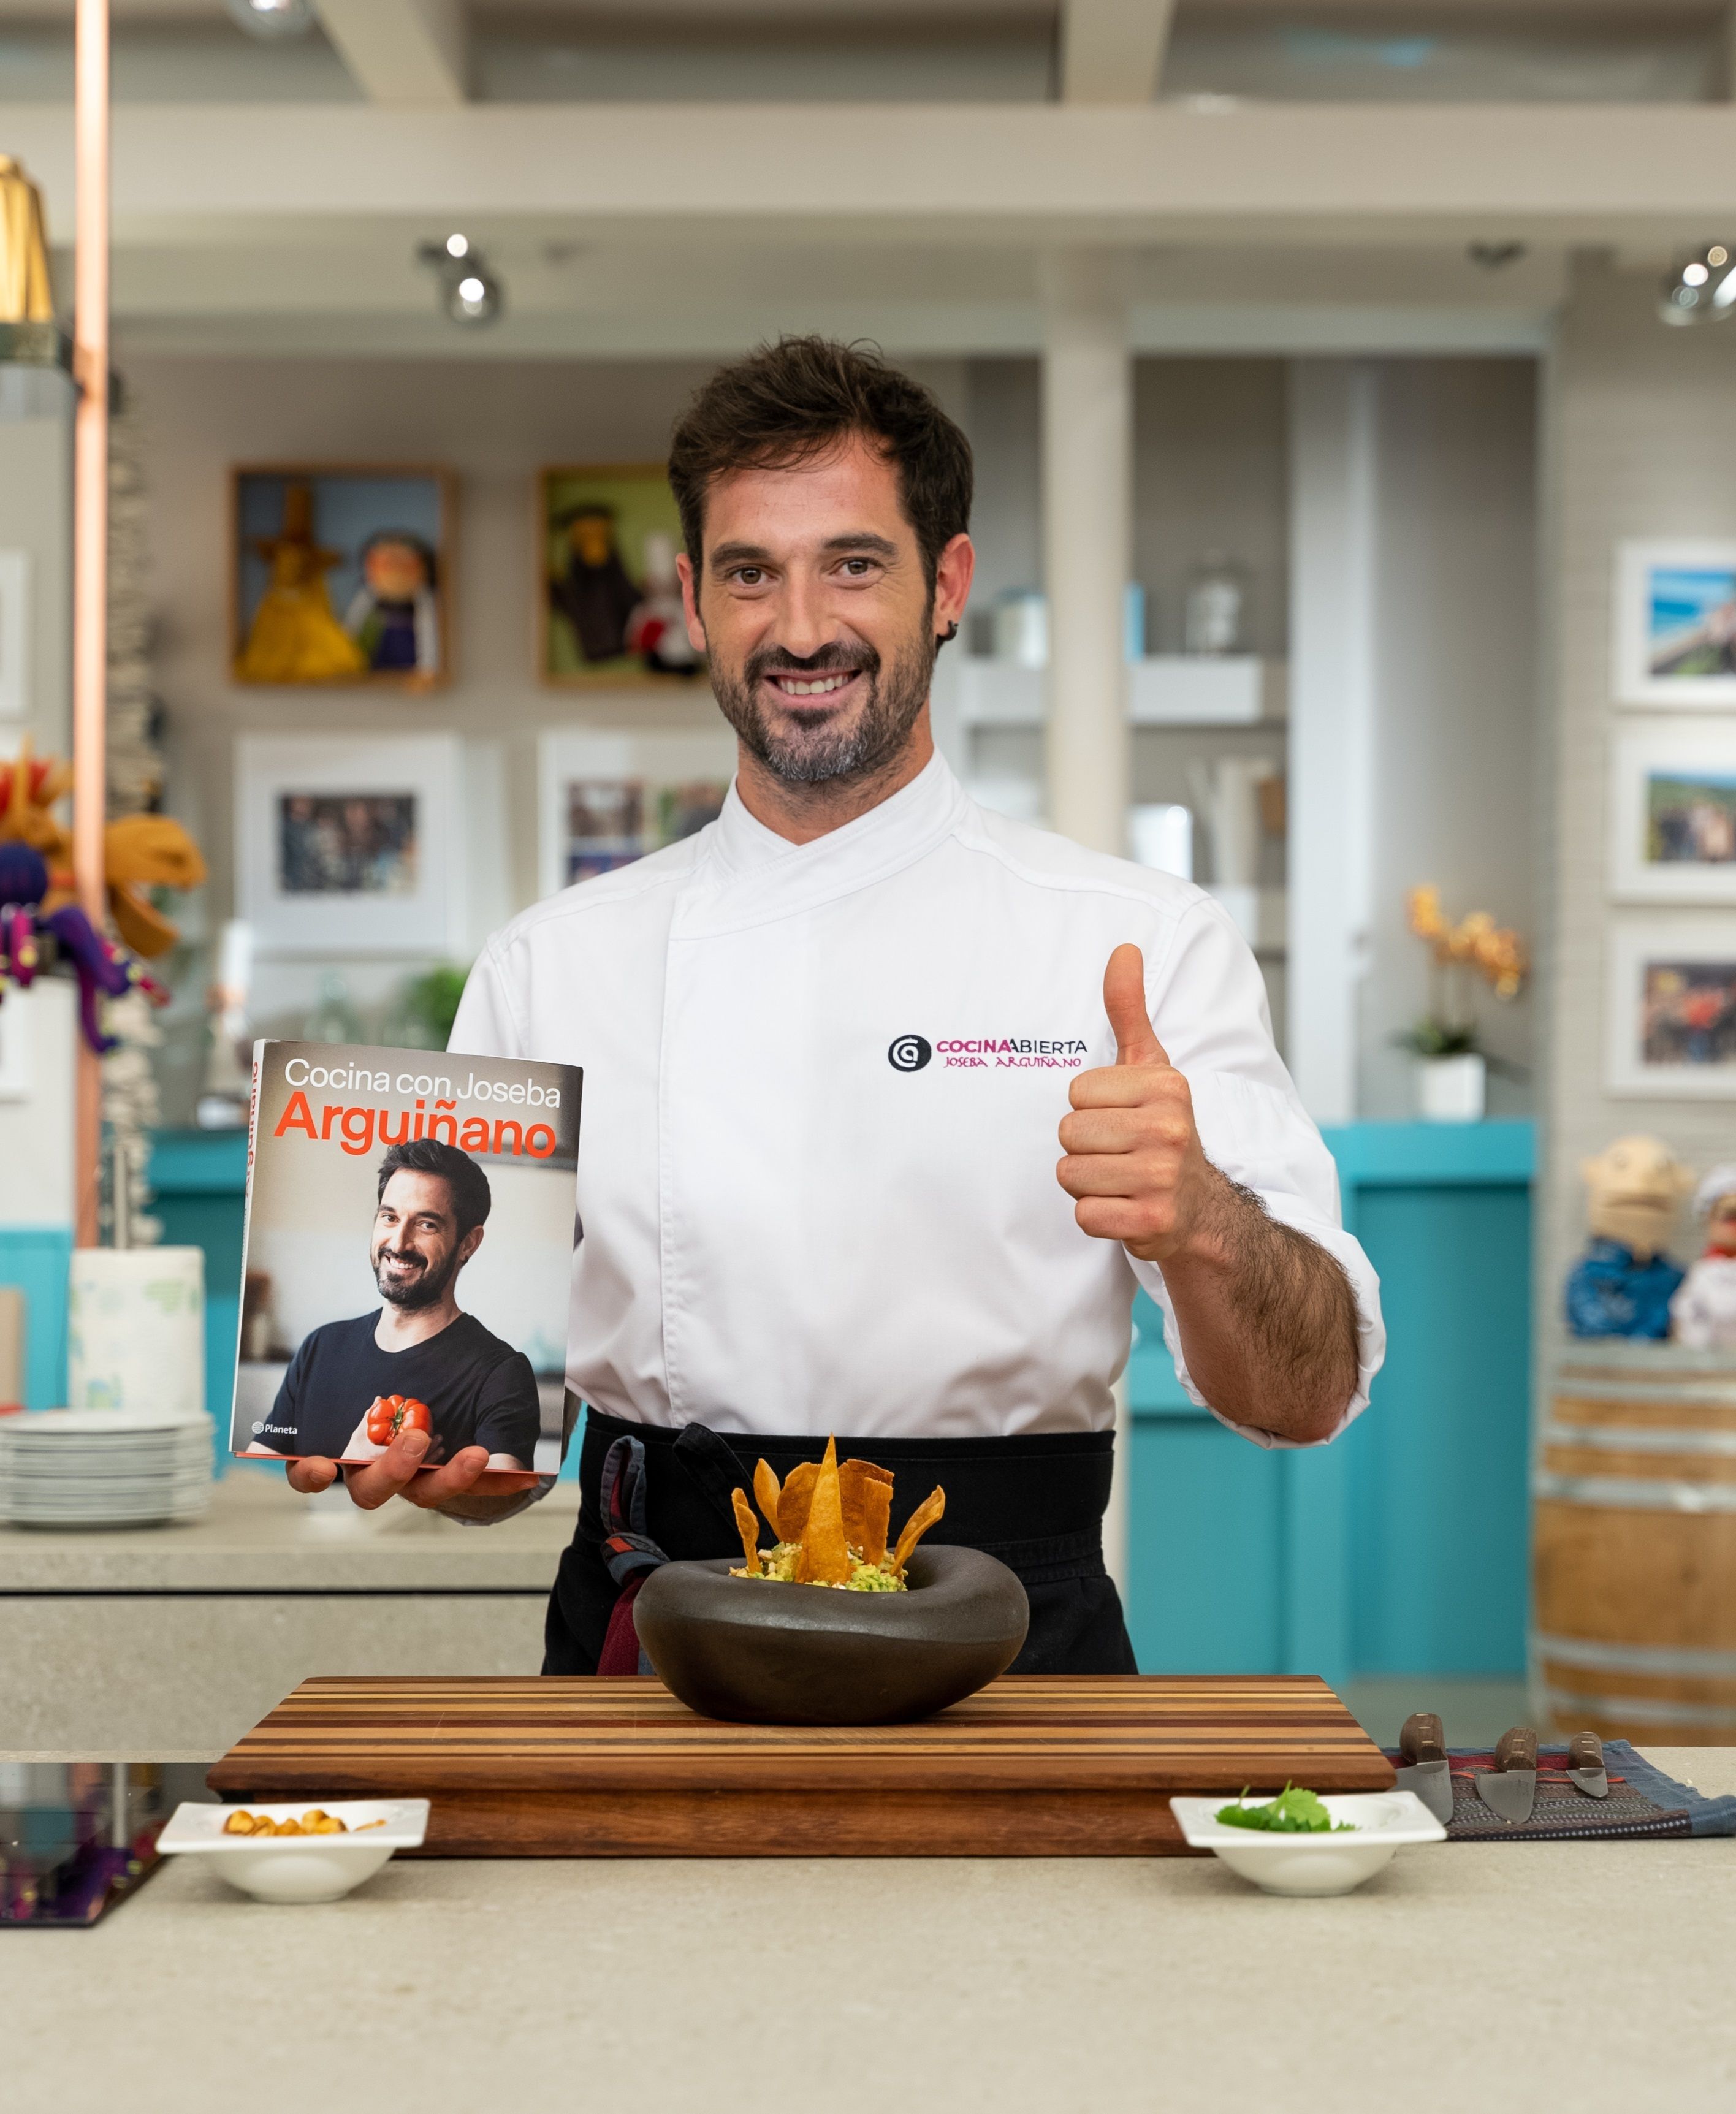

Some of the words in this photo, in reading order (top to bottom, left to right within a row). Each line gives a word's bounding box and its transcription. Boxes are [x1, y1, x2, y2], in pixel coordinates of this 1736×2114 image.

[943, 1056, 988, 1068] JOSEBA
[285, 1058, 390, 1093] Cocina
[395, 1073, 451, 1098] con
[457, 1073, 561, 1108] Joseba
[273, 1090, 556, 1158] Arguiñano
[265, 1424, 298, 1435] Planeta
